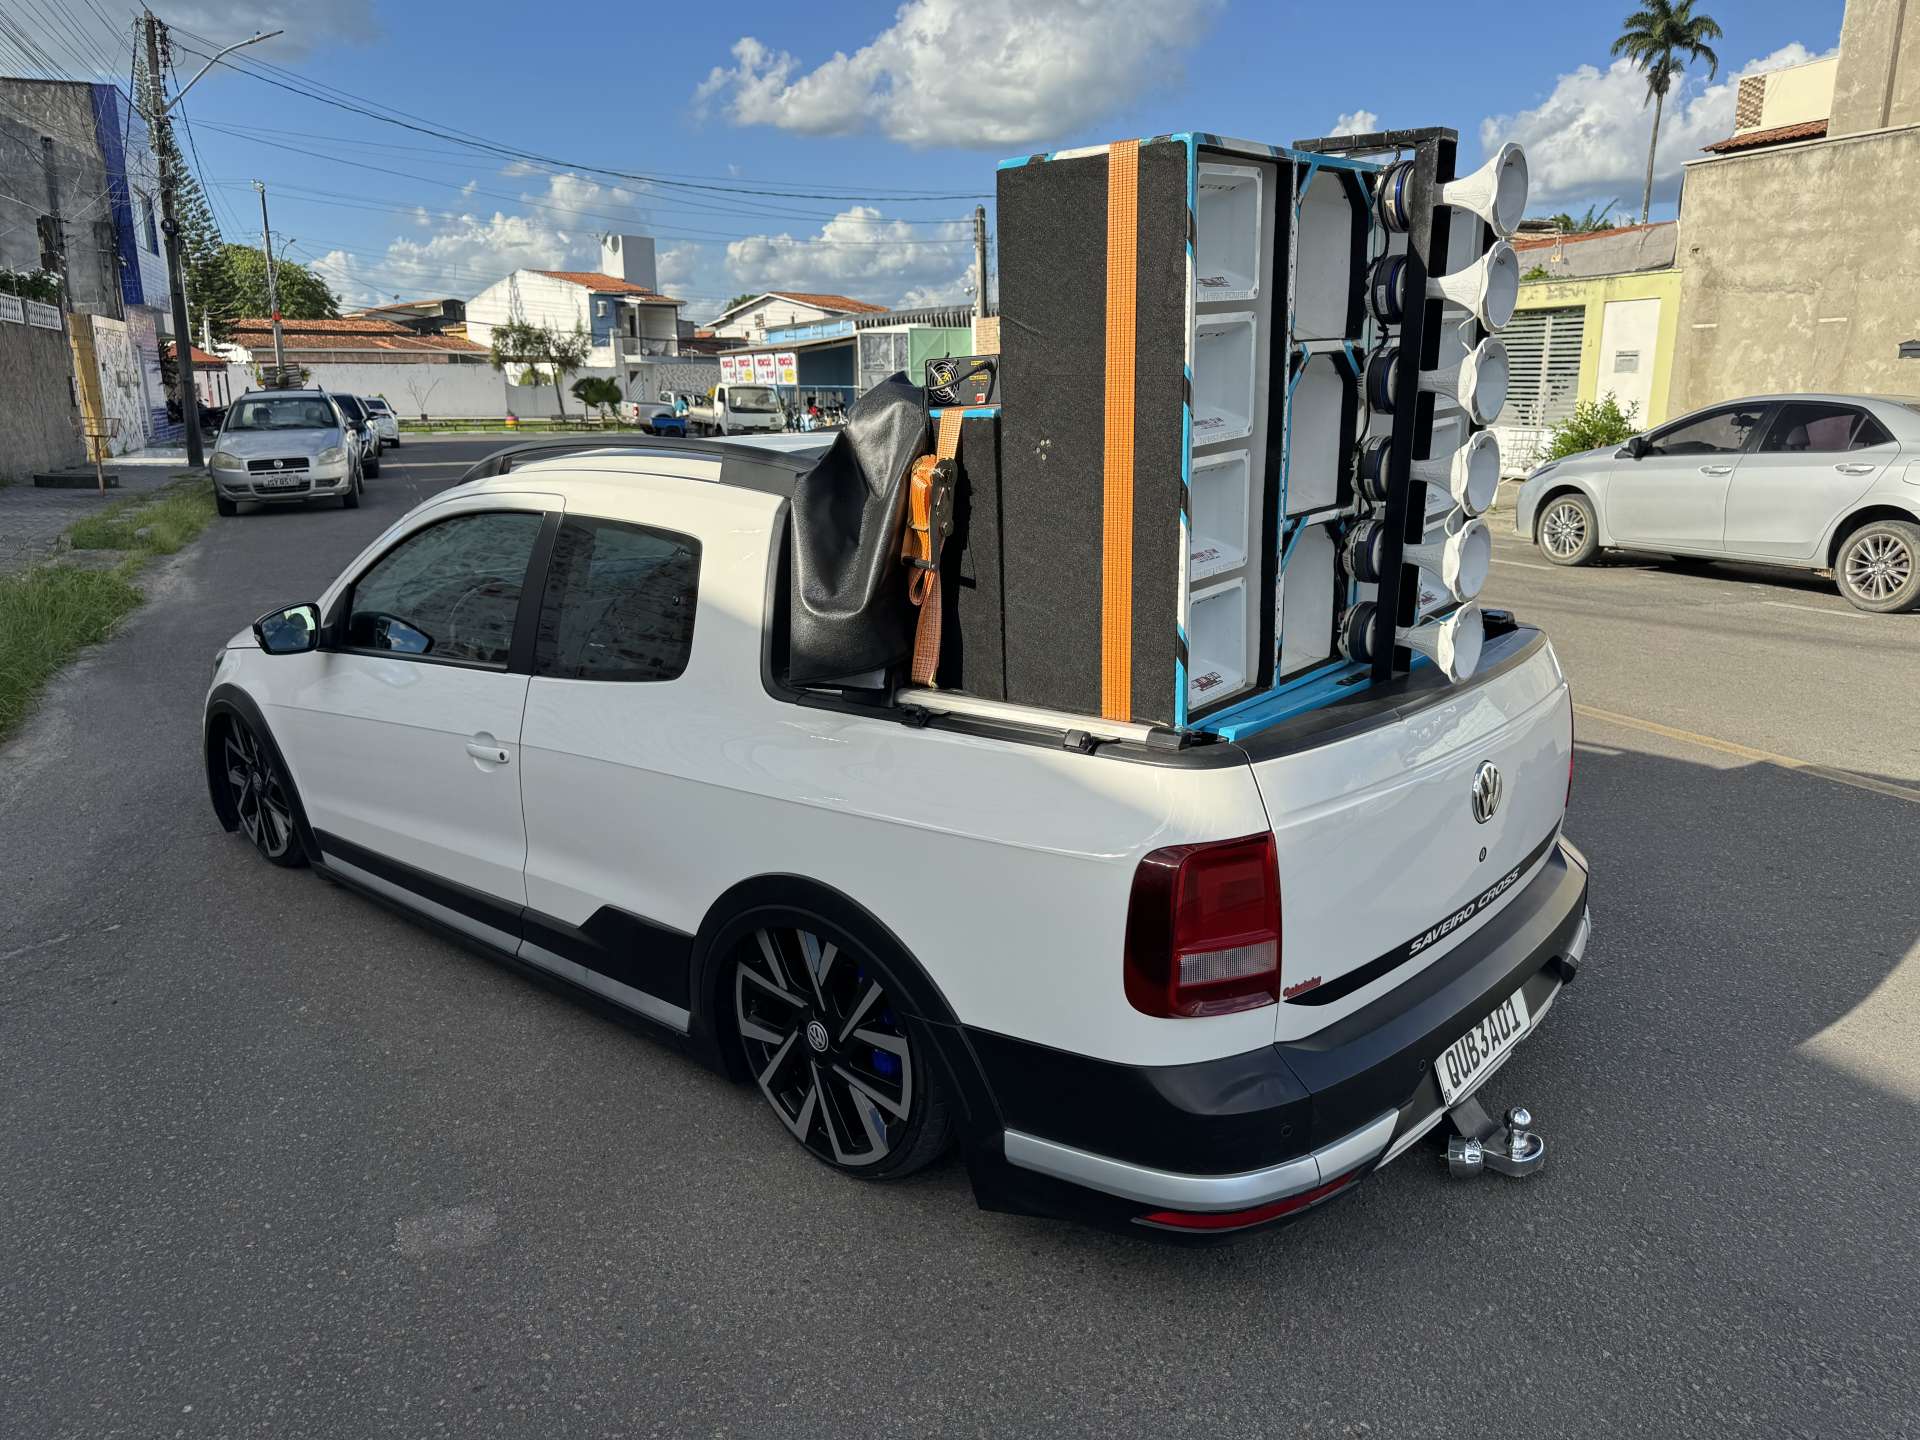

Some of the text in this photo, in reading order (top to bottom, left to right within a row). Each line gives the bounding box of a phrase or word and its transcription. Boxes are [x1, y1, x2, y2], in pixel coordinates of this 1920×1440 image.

[1409, 867, 1520, 956] SAVEIRO CROSS
[1445, 998, 1521, 1089] QUB3A01
